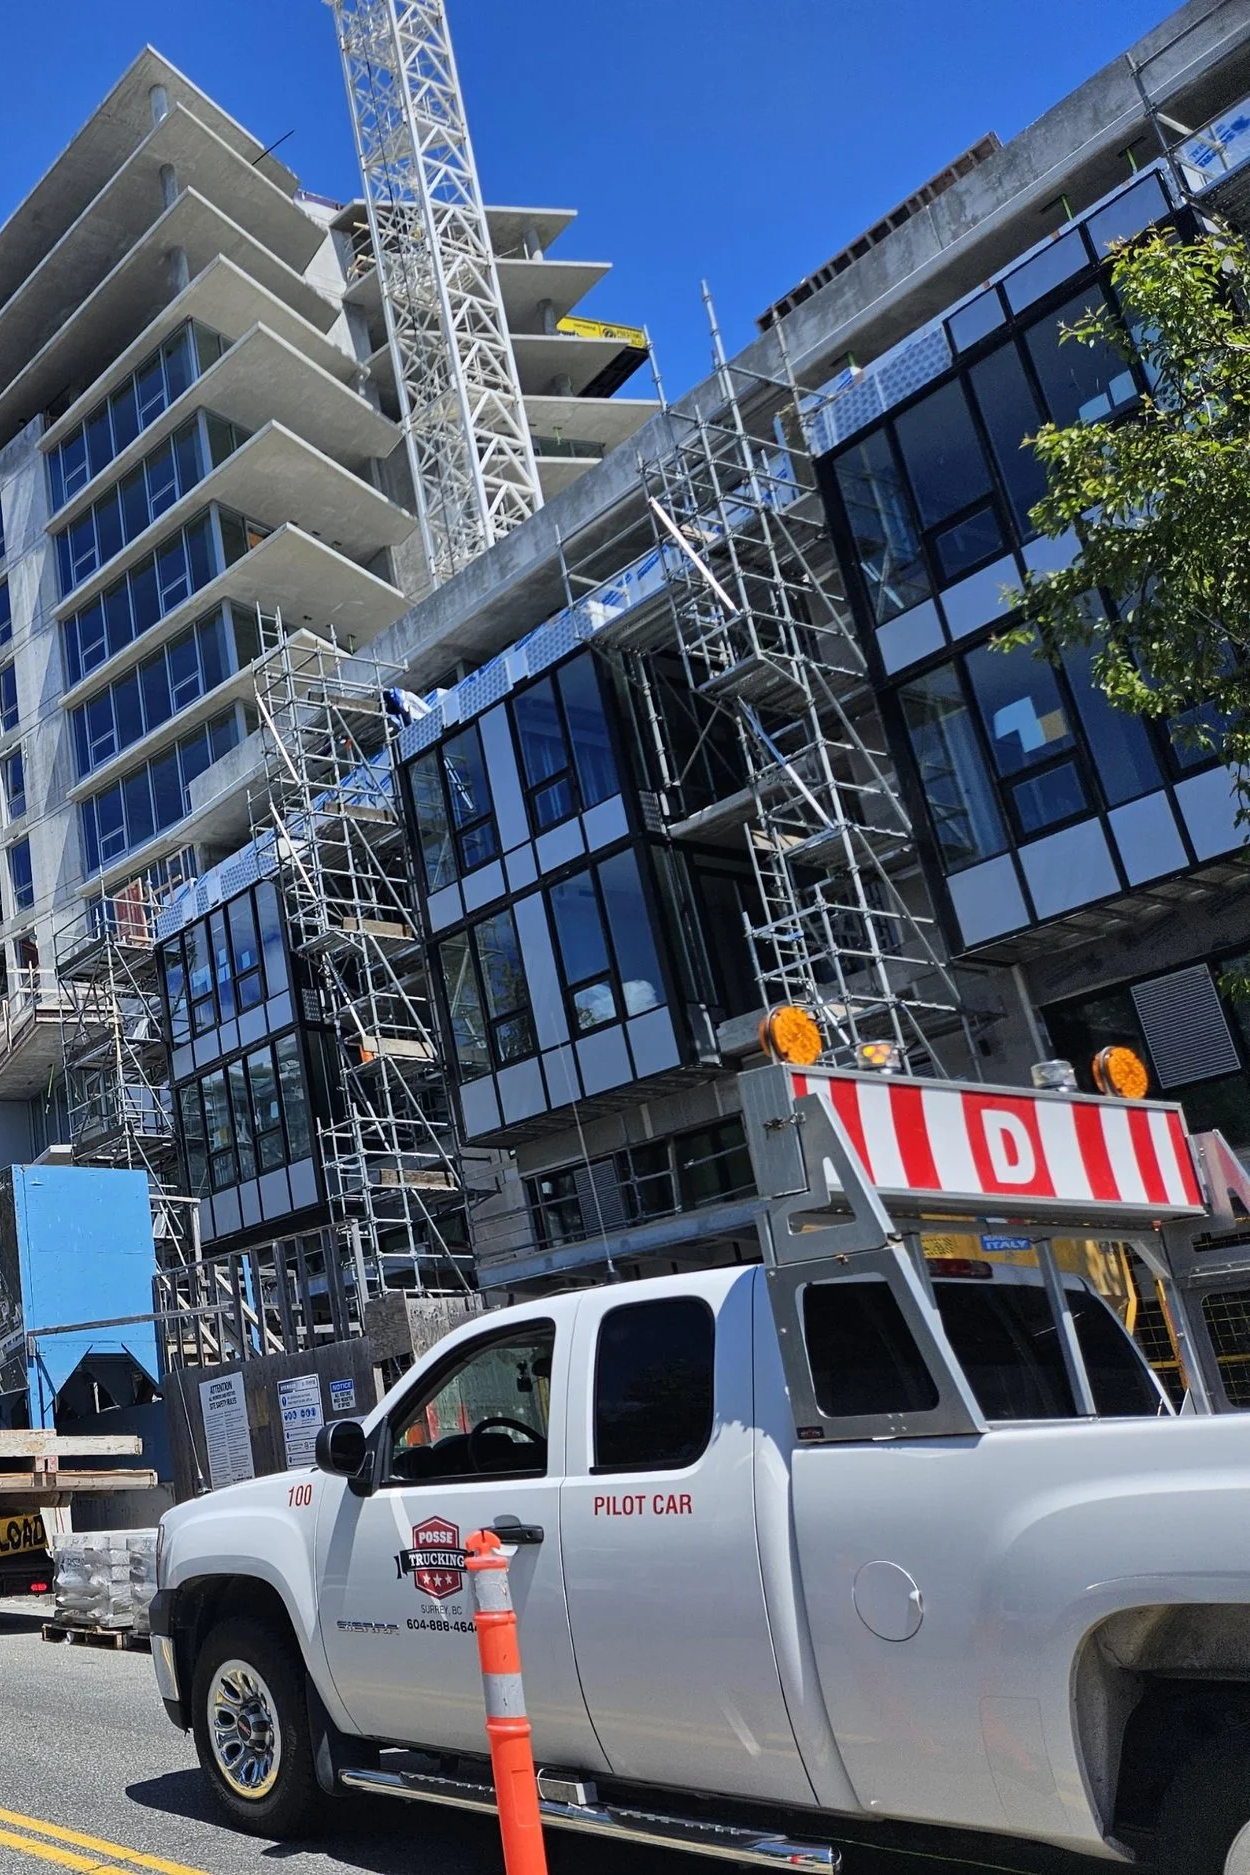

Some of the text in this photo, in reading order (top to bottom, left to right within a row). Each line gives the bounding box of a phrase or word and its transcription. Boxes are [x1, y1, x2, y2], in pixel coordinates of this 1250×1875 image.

[980, 1108, 1036, 1185] D
[985, 1240, 1028, 1250] ITALY
[210, 1381, 233, 1395] ATTENTION
[332, 1381, 352, 1392] NOTICE
[288, 1484, 312, 1507] 100
[594, 1494, 693, 1516] PILOT CAR
[418, 1531, 453, 1544] POSSE
[408, 1553, 465, 1567] TRUCKING
[451, 1605, 463, 1616] BC
[406, 1619, 478, 1633] 604-888-464
